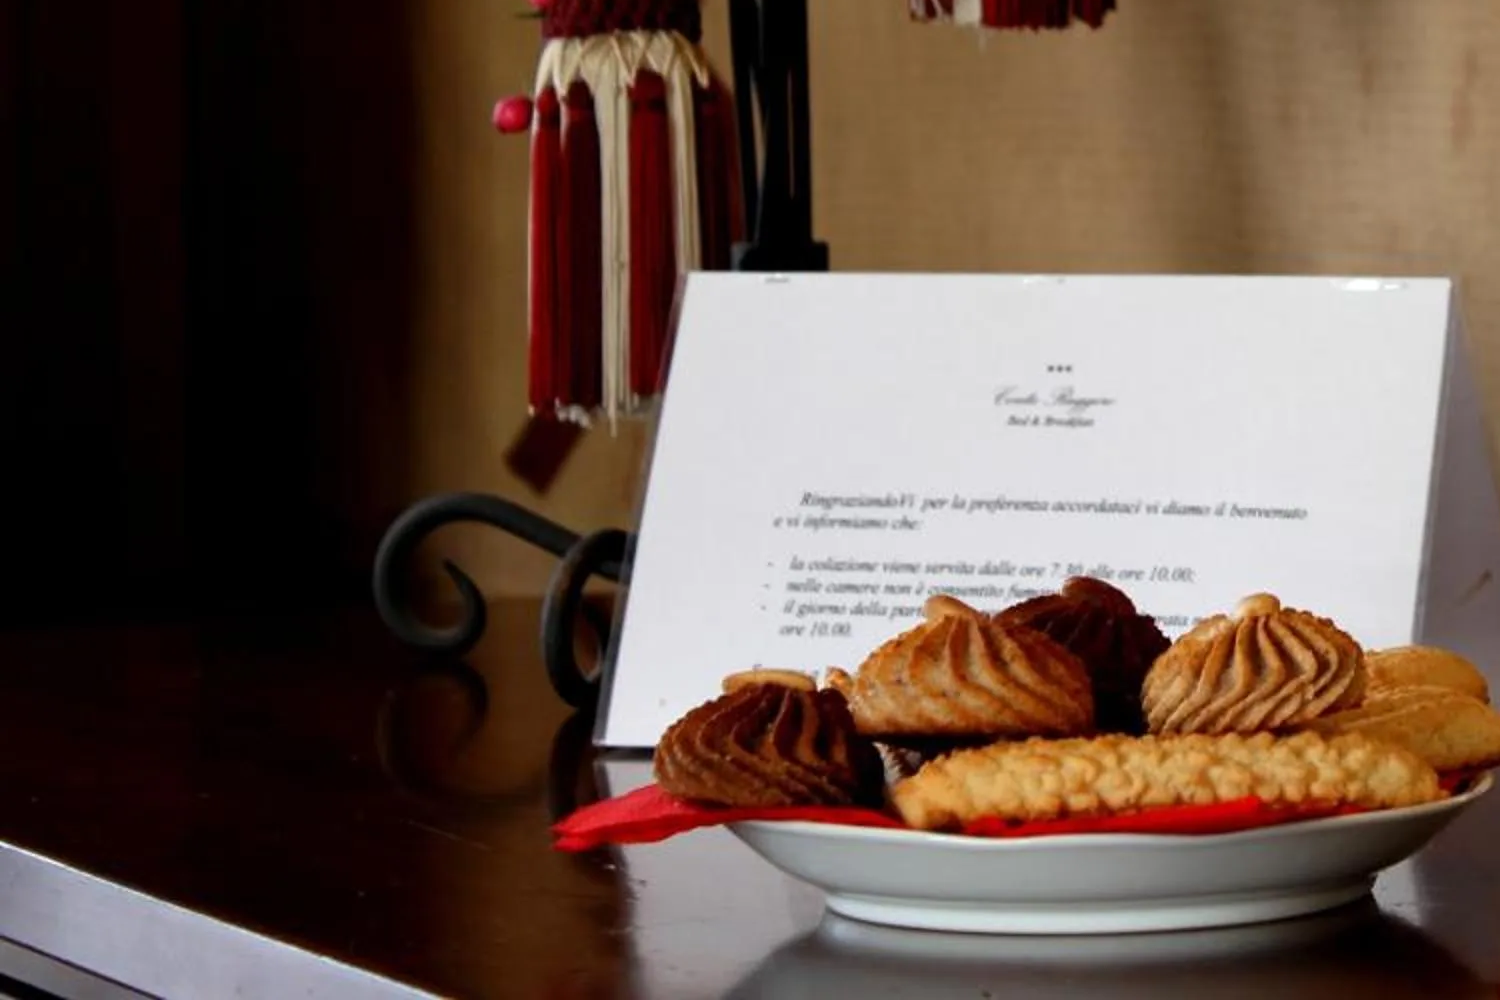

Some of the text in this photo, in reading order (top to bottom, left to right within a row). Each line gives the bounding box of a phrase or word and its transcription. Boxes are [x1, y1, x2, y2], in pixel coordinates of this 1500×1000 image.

[920, 499, 948, 512] per
[951, 495, 966, 510] la
[967, 496, 1049, 514] preferenza
[1146, 500, 1161, 515] vi
[1163, 500, 1210, 517] diamo
[1214, 501, 1228, 517] il
[1230, 503, 1308, 520] benvenuto
[773, 516, 783, 528] e
[787, 514, 799, 528] vi
[803, 514, 889, 531] informiamo
[789, 555, 804, 571] la
[808, 557, 878, 573] colazione
[881, 560, 920, 574] viene
[924, 561, 976, 576] servita
[978, 561, 1016, 577] dalle
[1019, 565, 1043, 578] ore
[1118, 569, 1145, 581] ore
[786, 577, 823, 593] nelle
[825, 583, 880, 595] camere
[883, 584, 911, 595] non
[783, 599, 794, 614] il
[796, 601, 847, 618] giorno
[849, 601, 886, 617] della
[779, 625, 804, 637] ore
